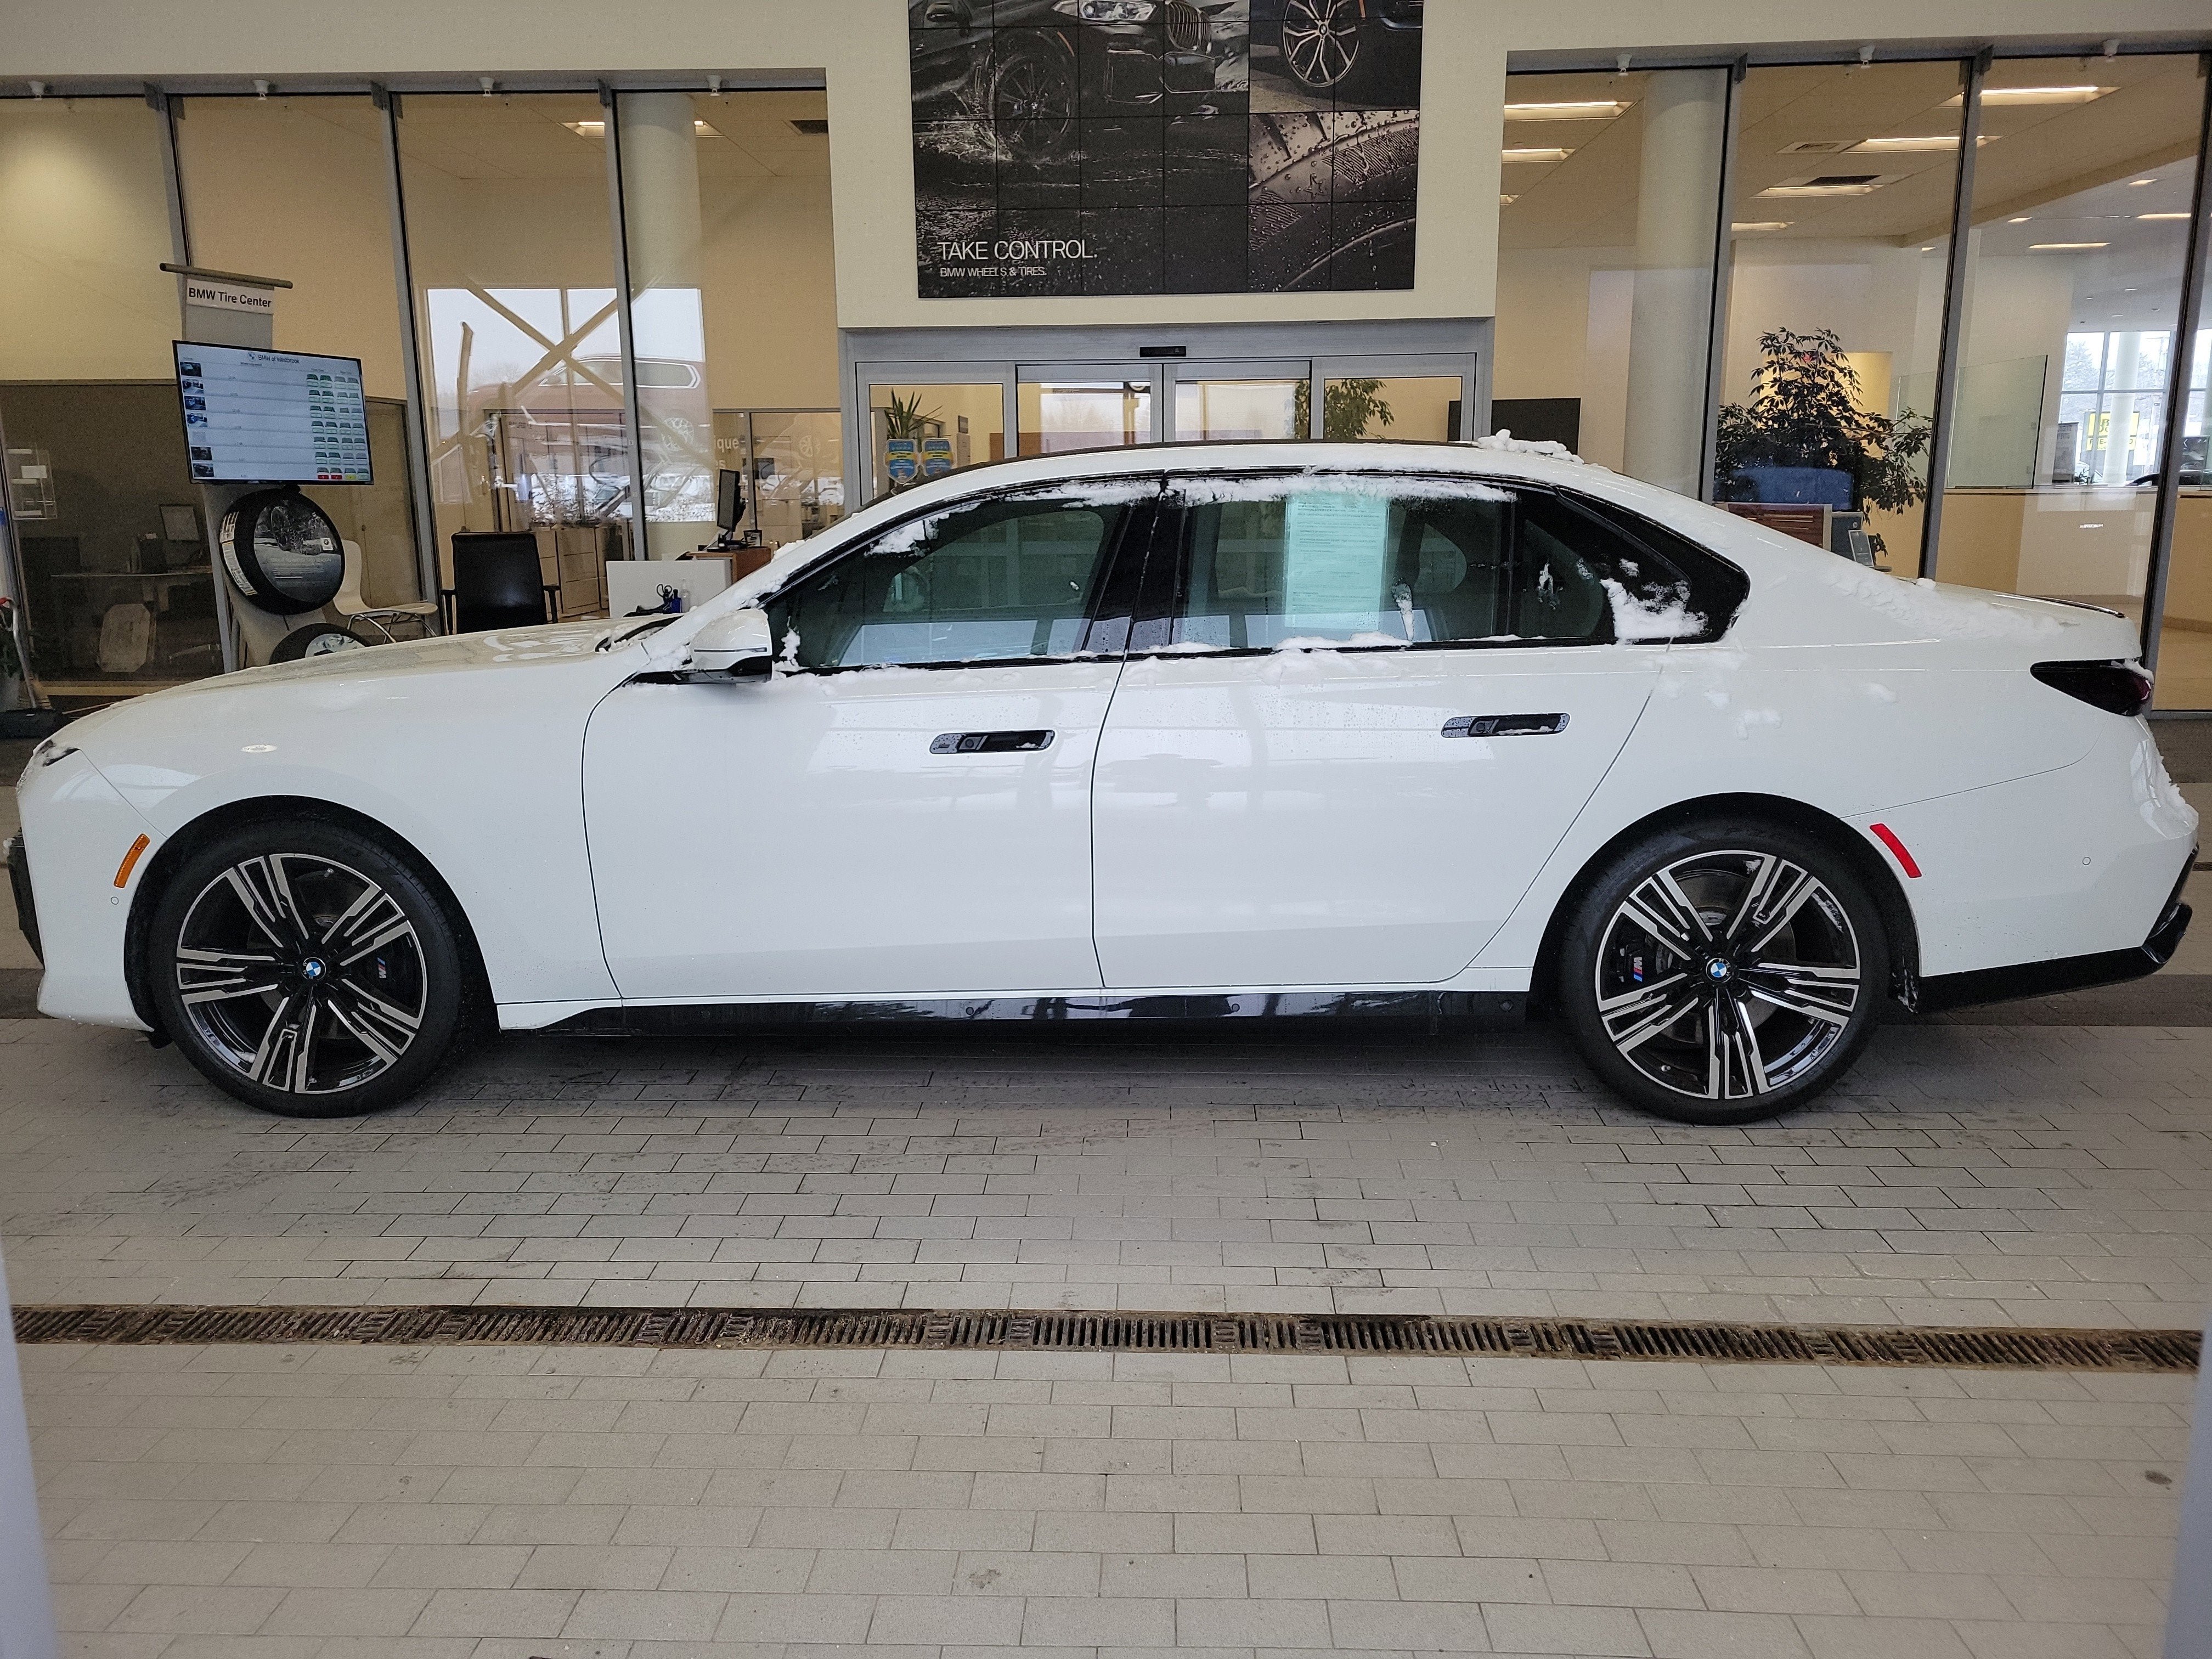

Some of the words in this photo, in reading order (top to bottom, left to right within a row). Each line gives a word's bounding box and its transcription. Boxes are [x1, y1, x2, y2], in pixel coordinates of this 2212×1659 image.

[936, 241, 989, 260] TAKE
[994, 239, 1097, 259] CONTROL.
[939, 267, 966, 277] BMW
[967, 267, 1007, 276] WHEELS
[1009, 267, 1016, 276] &
[1018, 266, 1047, 276] TIRES.
[189, 287, 216, 300] BMW
[218, 291, 237, 303] Tire
[240, 294, 272, 308] Center
